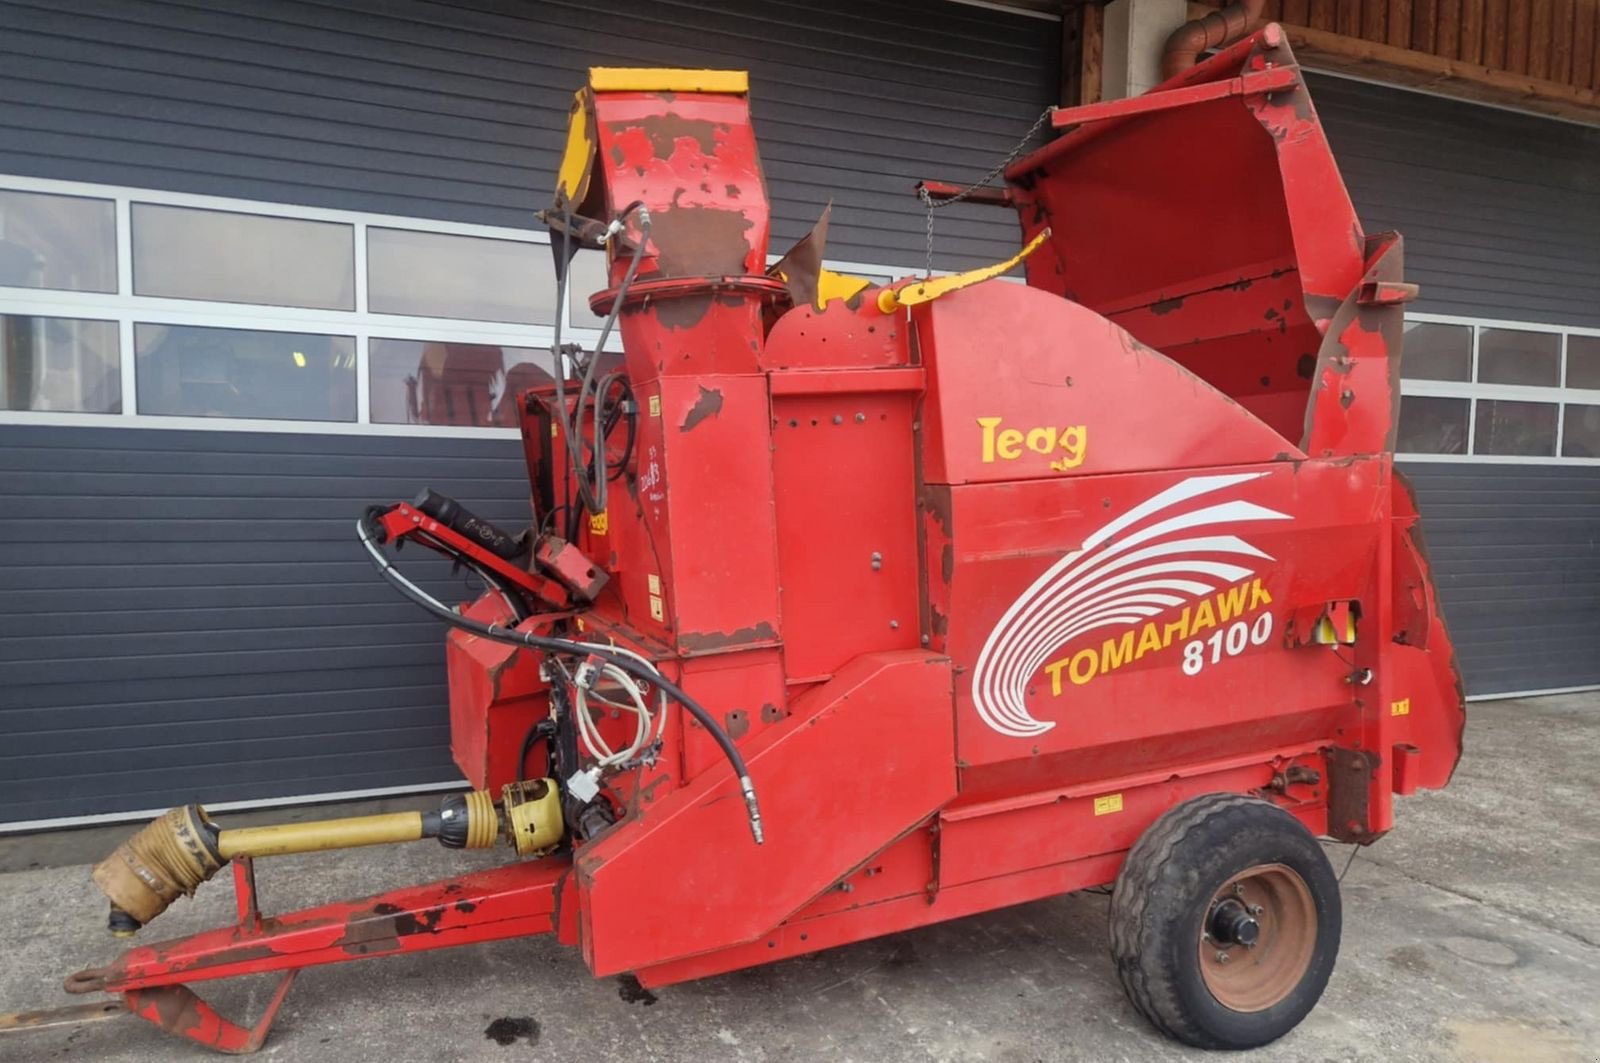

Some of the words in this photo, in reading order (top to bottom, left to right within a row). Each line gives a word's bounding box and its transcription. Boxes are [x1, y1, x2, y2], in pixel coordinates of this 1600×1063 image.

[976, 416, 1087, 472] Teag
[1044, 578, 1273, 697] TOMAHAWK
[1182, 611, 1273, 676] 8100
